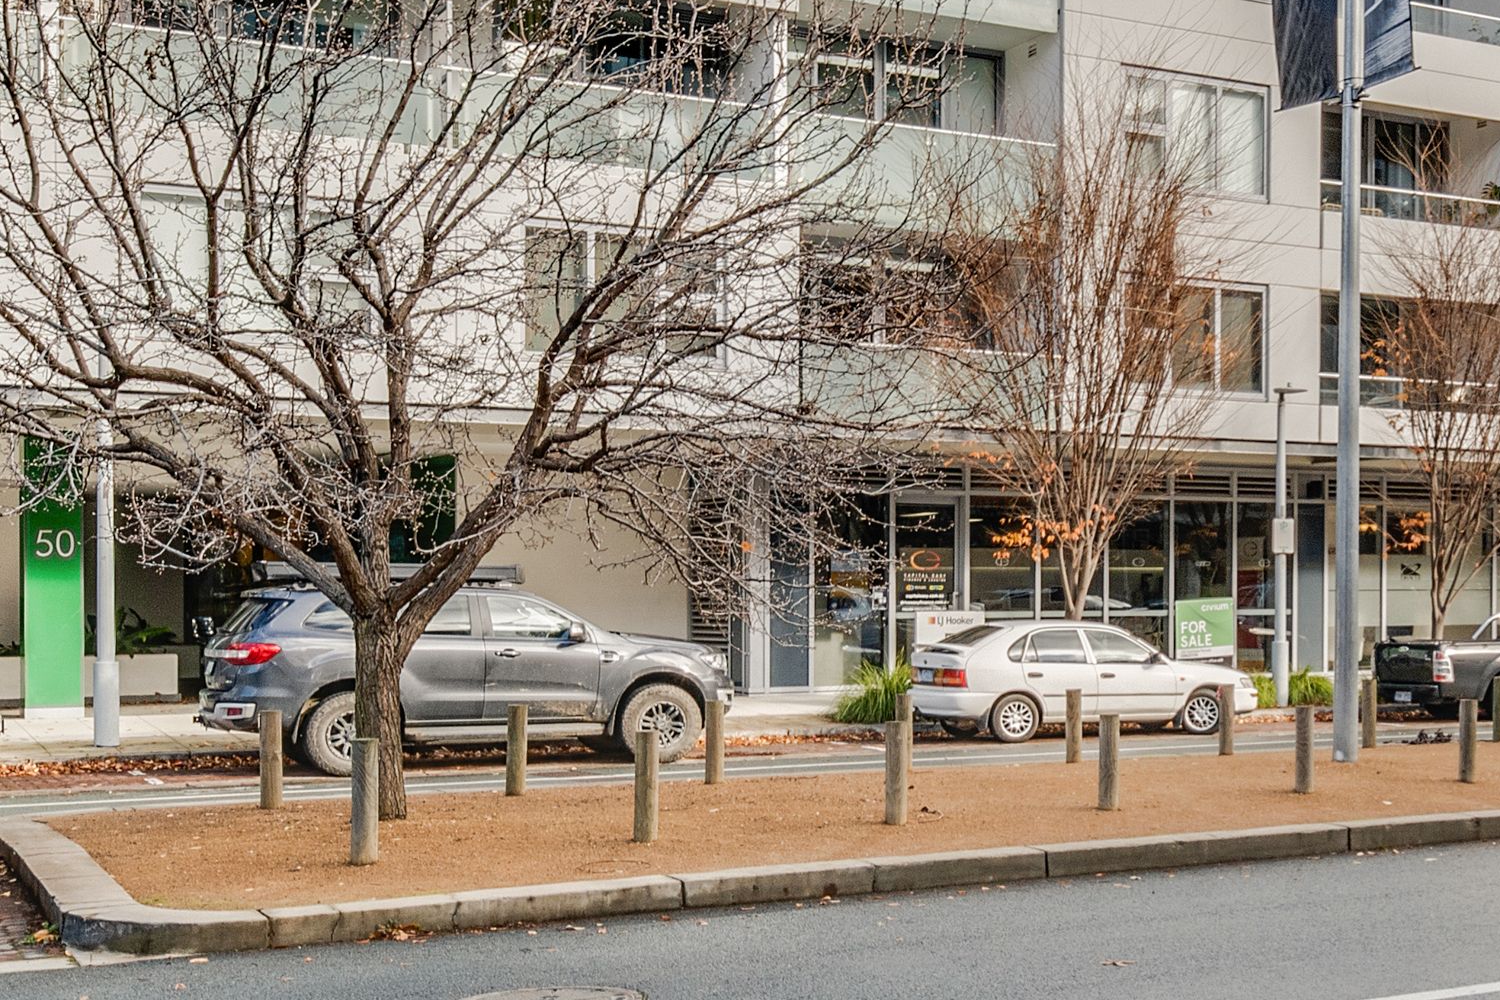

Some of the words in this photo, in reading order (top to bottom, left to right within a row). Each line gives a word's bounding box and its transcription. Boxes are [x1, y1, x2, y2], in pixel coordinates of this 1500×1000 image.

[36, 529, 75, 557] 50
[937, 616, 944, 627] LJ
[946, 616, 974, 625] Hooker
[1181, 620, 1207, 634] FOR
[1180, 633, 1213, 648] SALE
